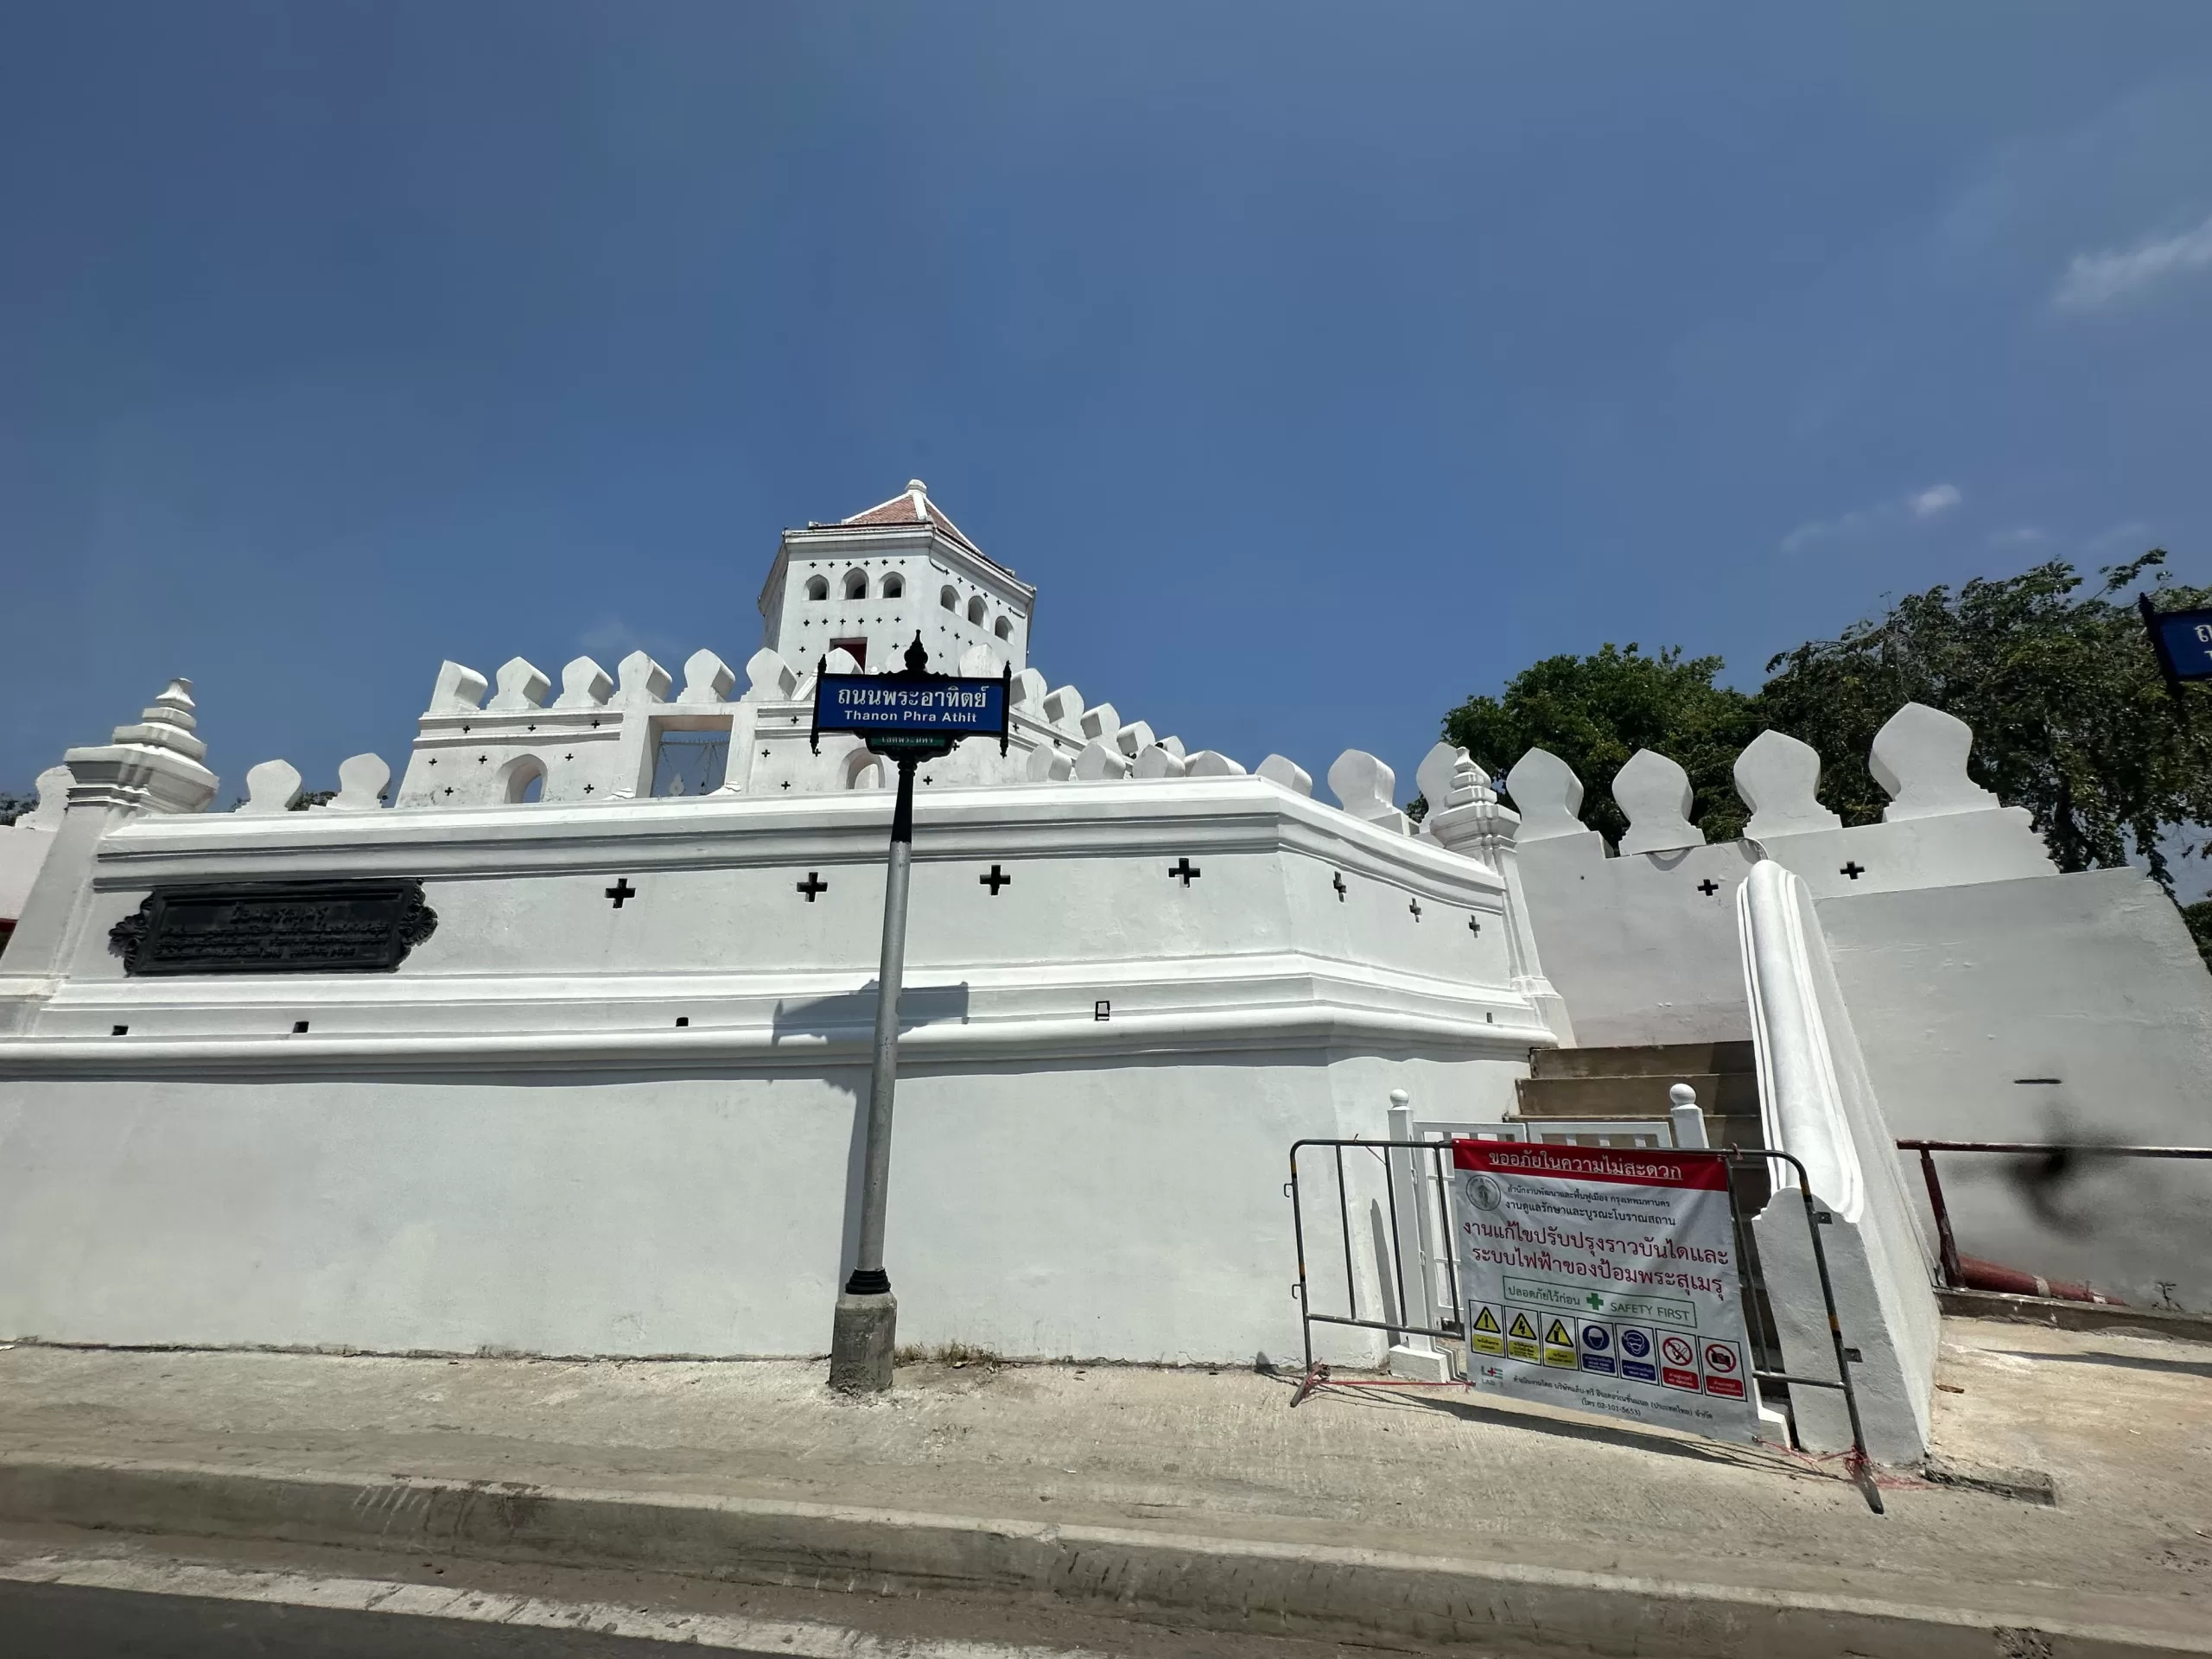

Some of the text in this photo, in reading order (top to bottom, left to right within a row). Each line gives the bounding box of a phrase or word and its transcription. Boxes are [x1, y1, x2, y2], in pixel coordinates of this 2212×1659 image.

[838, 685, 989, 709] ถนนพระอาทิตย์
[844, 710, 977, 723] Thanon Phra Athit
[1489, 1150, 1682, 1179] ขออภัยในความไม่สะดวก
[1505, 1201, 1676, 1226] งานดูแลรักษาและบูรณะโบราณสถาน
[1611, 1196, 1670, 1207] กรุงเทพมหานคร
[1463, 1220, 1729, 1266] งานแก้ไขปรับปรุงราวบันไดและ
[1472, 1247, 1725, 1301] ระบบไฟฟ้าของป้อมพระสุเมรุ
[1508, 1286, 1580, 1306] ปลอดภัยไว้ก่อน
[1610, 1301, 1690, 1320] SAFETY FIRST
